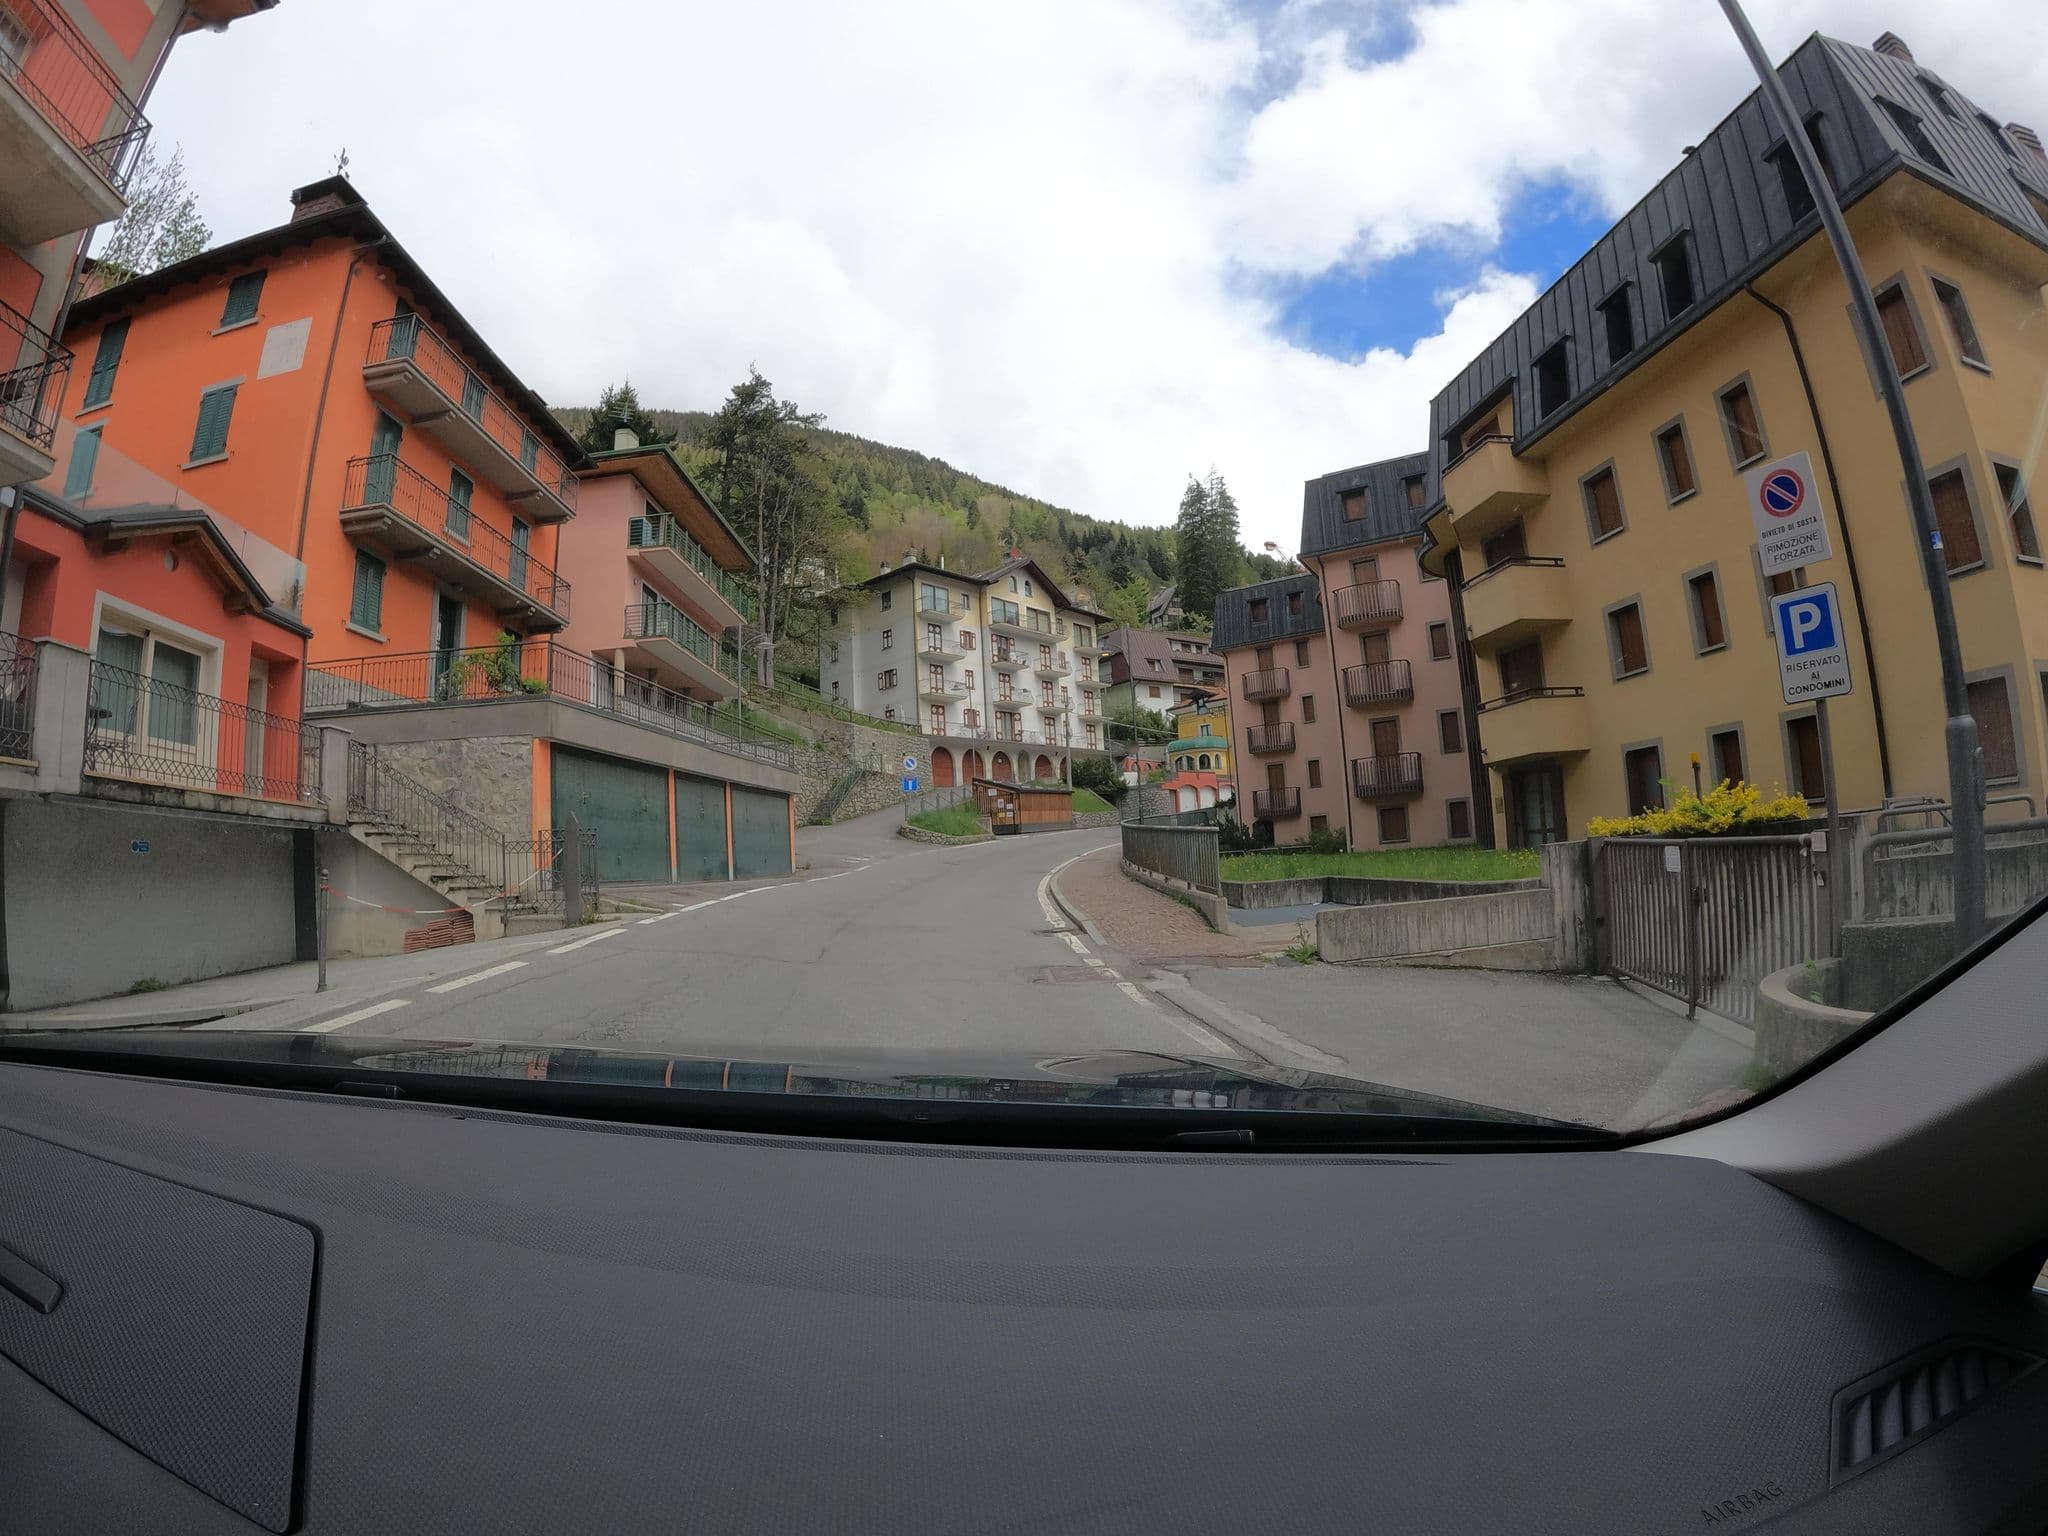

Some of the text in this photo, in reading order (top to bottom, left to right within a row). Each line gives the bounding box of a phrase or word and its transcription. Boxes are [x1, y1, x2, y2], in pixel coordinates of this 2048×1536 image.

[1762, 516, 1817, 539] DIVIETO DI SOSTA
[1767, 532, 1819, 554] RIMOZIONE
[1774, 545, 1816, 563] FORZATA
[1788, 602, 1822, 649] P
[1786, 655, 1841, 672] RISERVATO
[1811, 671, 1820, 681] AI
[1788, 678, 1845, 695] CONDOMINI
[1702, 1481, 1784, 1526] AIRBAG
